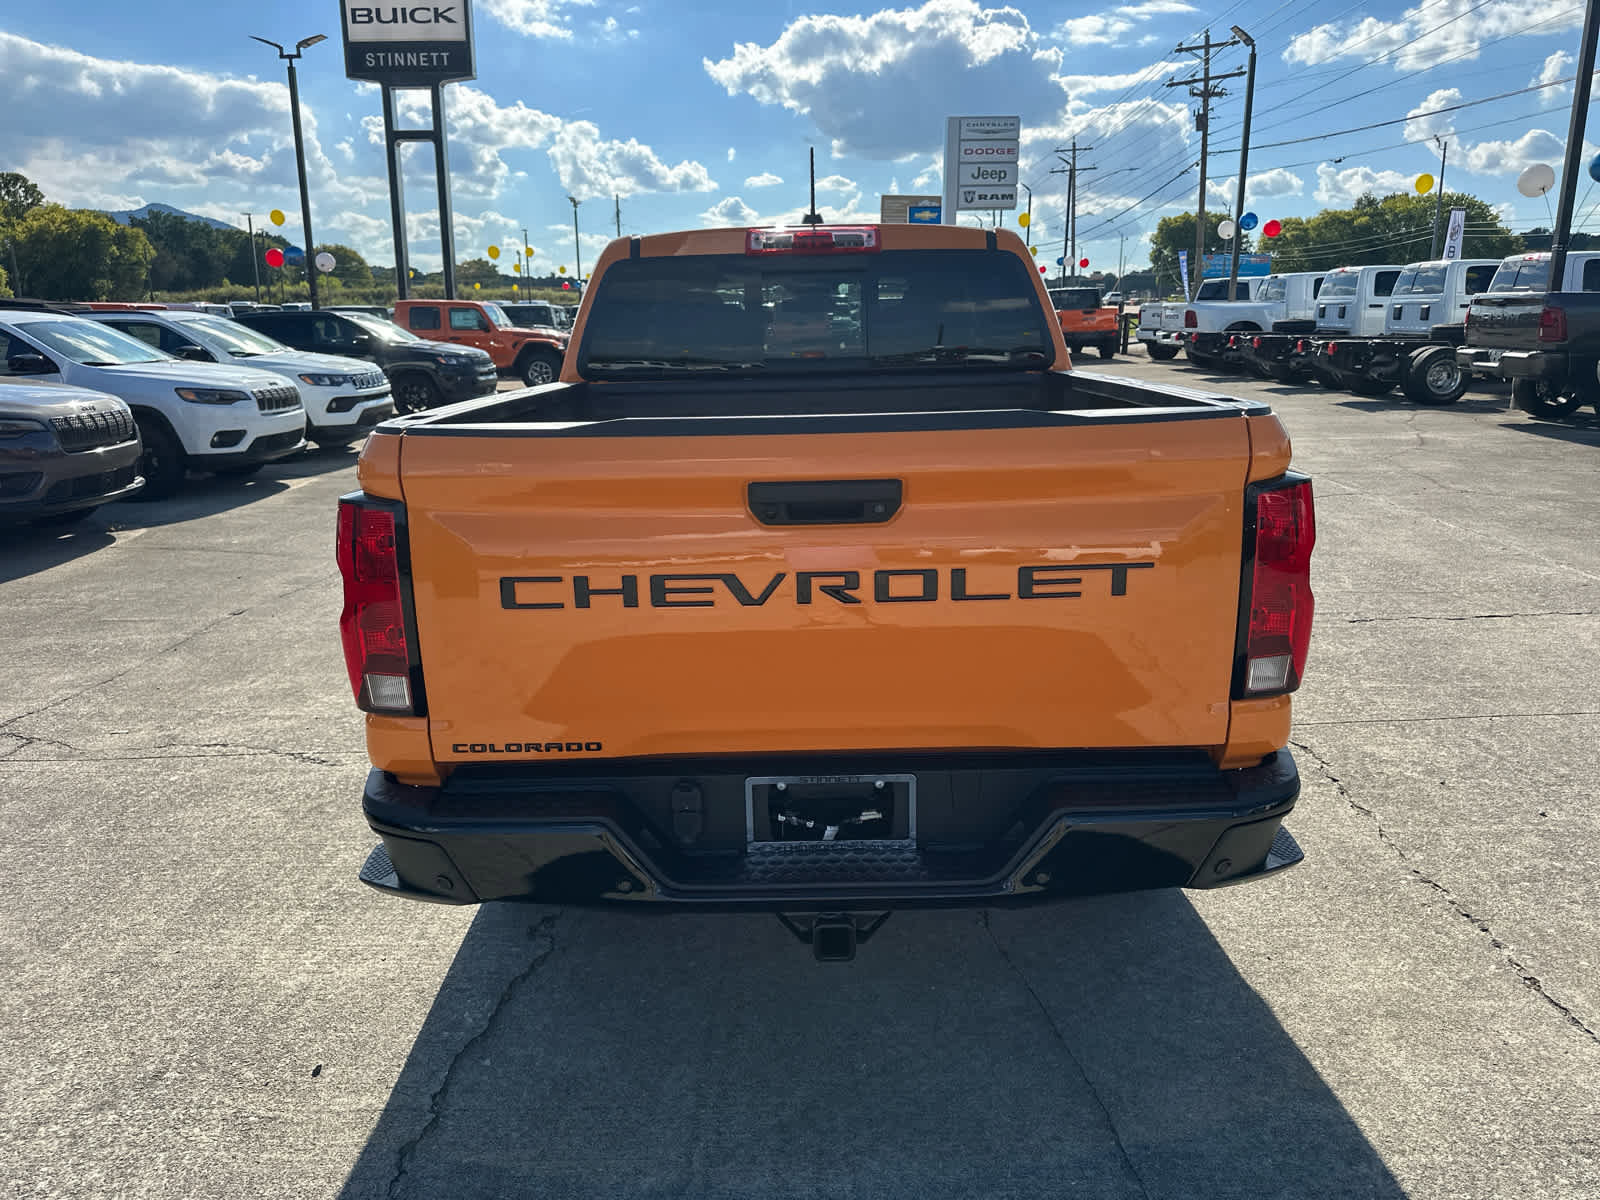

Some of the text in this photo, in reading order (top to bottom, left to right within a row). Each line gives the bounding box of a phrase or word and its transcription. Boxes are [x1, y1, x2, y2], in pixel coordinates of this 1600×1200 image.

[350, 7, 458, 24] BUICK
[365, 52, 449, 67] STINNETT
[971, 166, 1007, 182] Jeep
[978, 193, 1014, 201] RAM
[499, 562, 1154, 610] CHEVROLET
[452, 742, 602, 753] COLORADO
